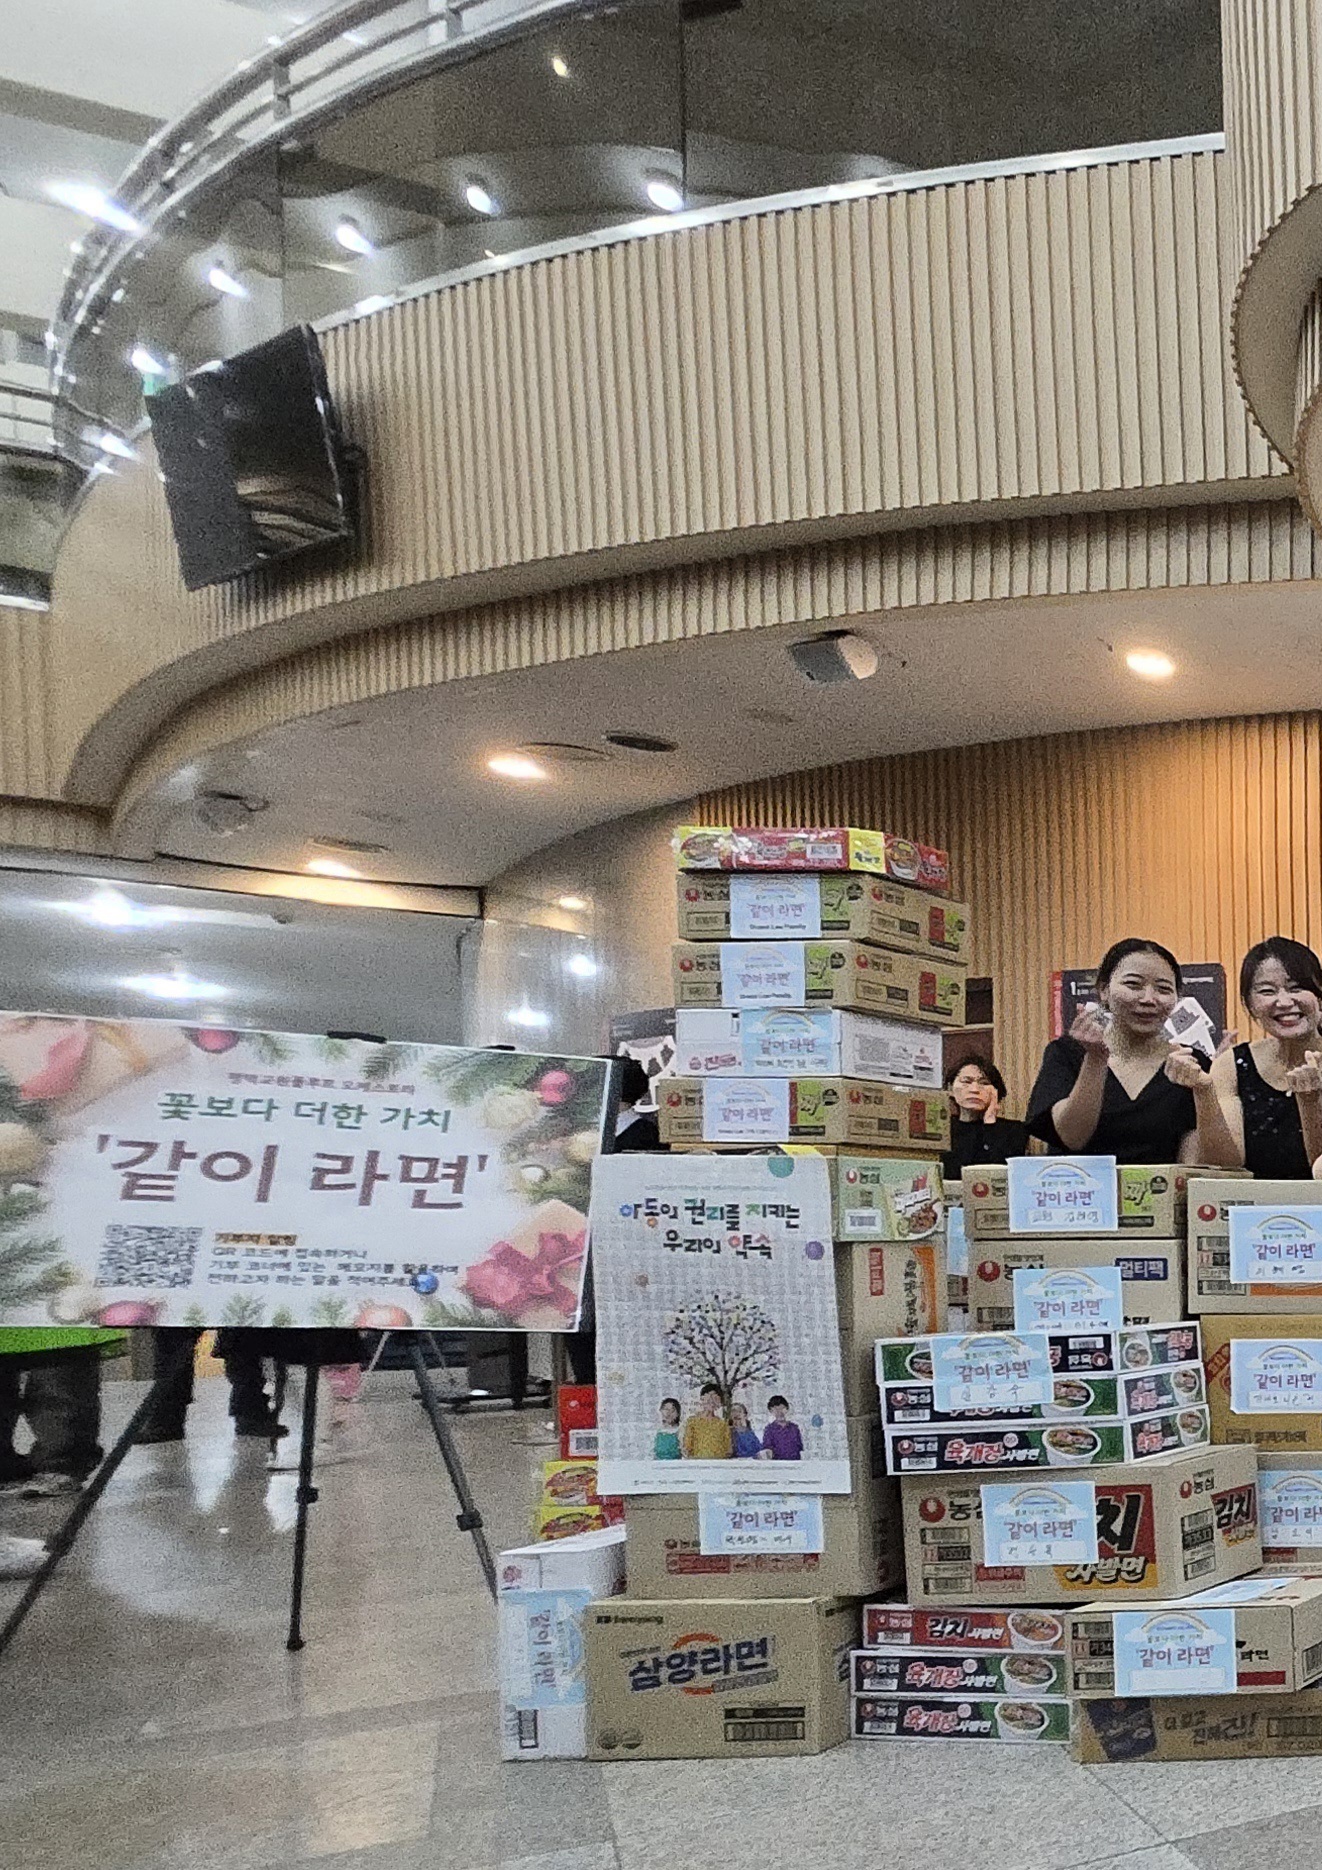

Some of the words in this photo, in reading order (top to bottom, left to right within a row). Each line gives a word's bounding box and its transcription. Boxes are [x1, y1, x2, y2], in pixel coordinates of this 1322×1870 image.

[157, 1092, 279, 1122] 꽃보다
[294, 1102, 369, 1129] 더한
[381, 1107, 452, 1133] 가치
[619, 1198, 678, 1228] 아동의
[685, 1198, 740, 1231] 권리를
[746, 1203, 800, 1229] 지키는
[663, 1230, 721, 1254] 우리의
[728, 1234, 772, 1259] 약속
[1120, 1261, 1166, 1278] 멀티팩
[1066, 1557, 1146, 1583] 사발면
[929, 1617, 967, 1639] 김치
[629, 1637, 772, 1692] 삼양라면
